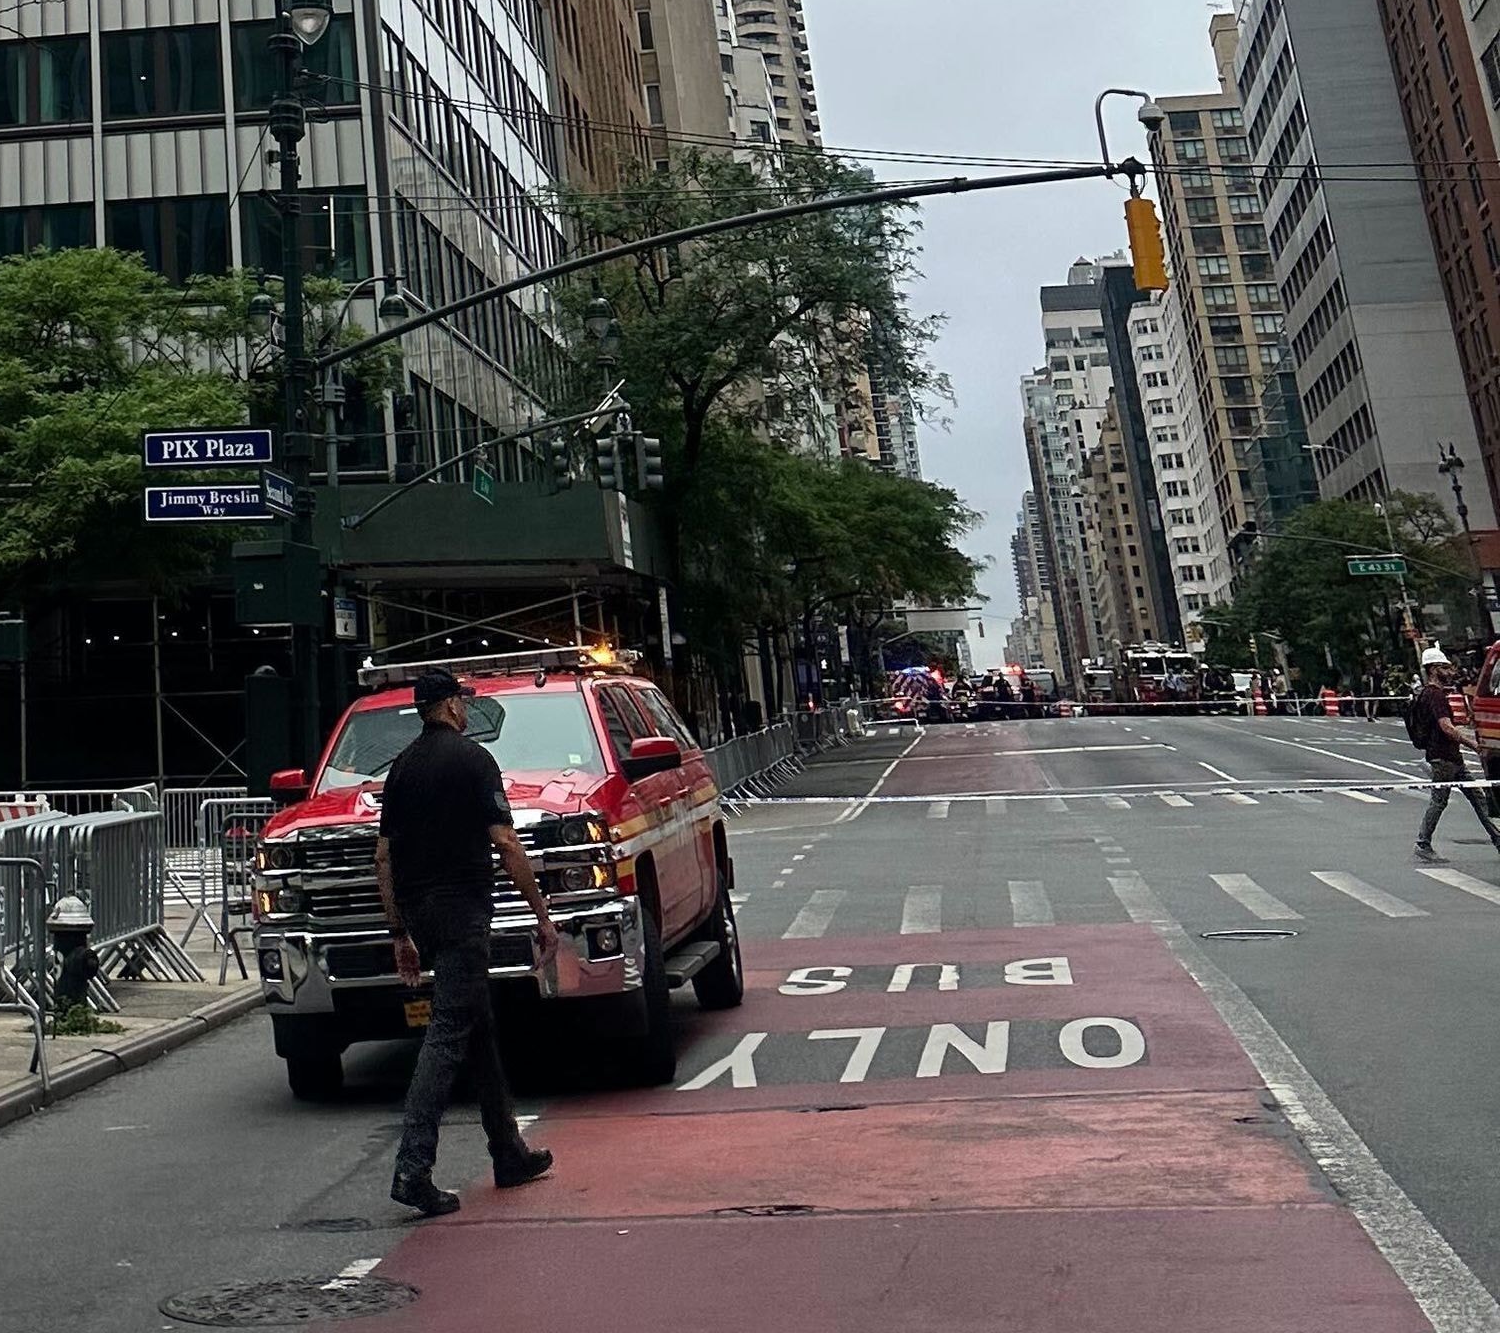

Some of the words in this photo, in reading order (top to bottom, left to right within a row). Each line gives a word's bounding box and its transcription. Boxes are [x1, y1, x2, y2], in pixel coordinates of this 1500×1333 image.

[161, 440, 199, 459] PIX
[205, 438, 255, 458] Plaza
[160, 492, 206, 508] Jimmy
[209, 489, 260, 504] Breslin
[202, 505, 226, 517] Way
[1359, 564, 1366, 572] E
[778, 956, 1073, 996] BUS
[675, 1016, 1146, 1091] ONLY
